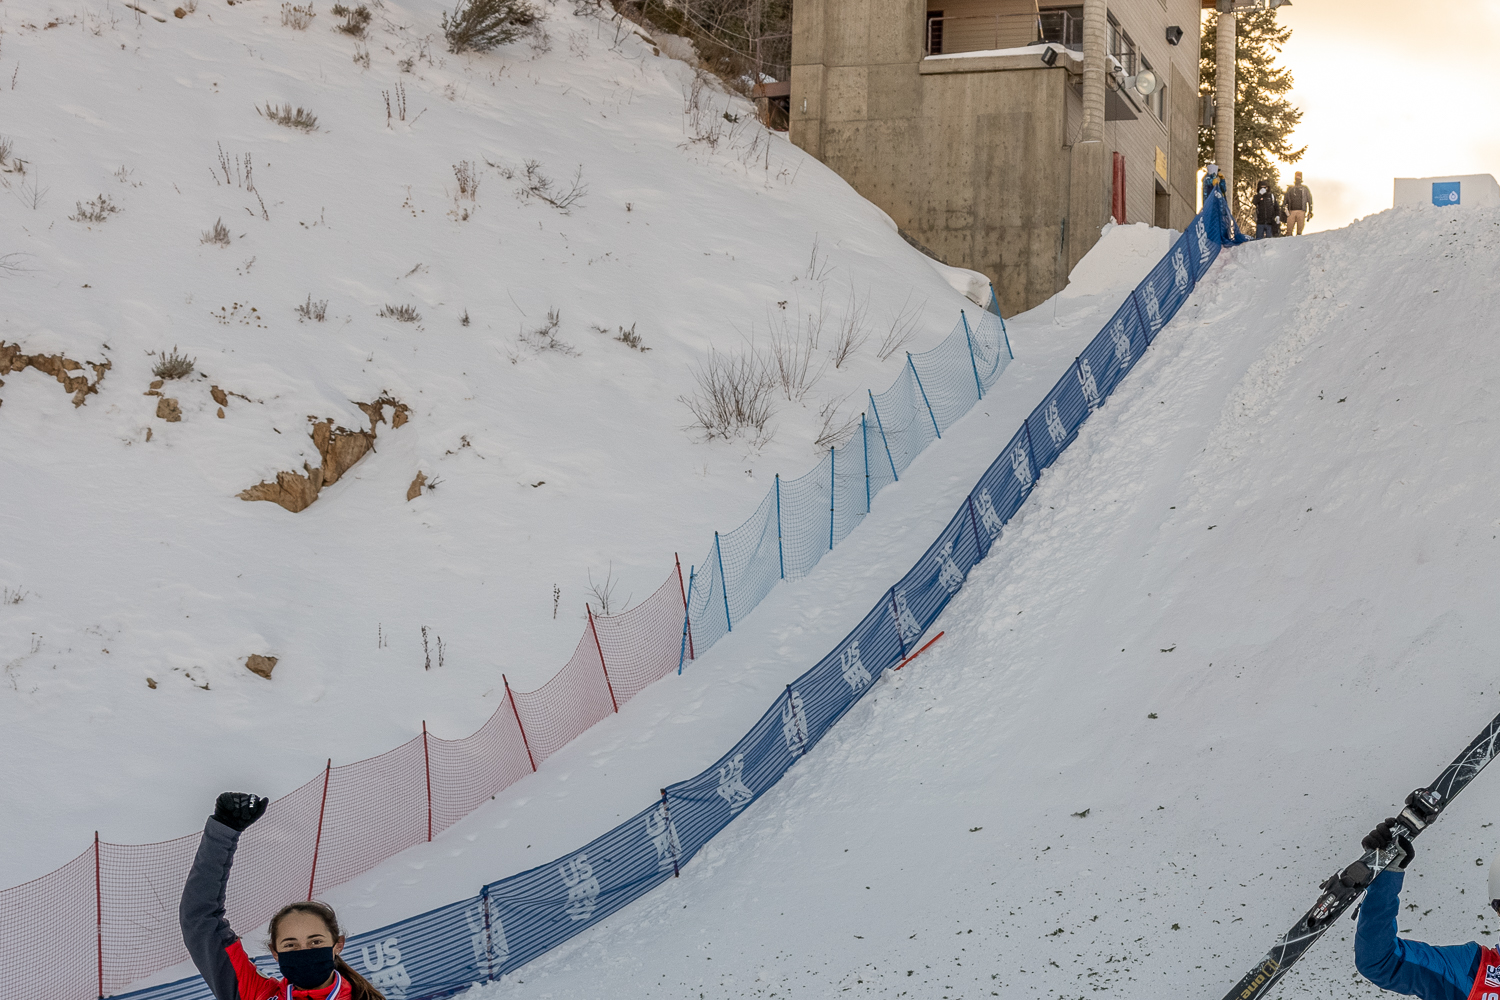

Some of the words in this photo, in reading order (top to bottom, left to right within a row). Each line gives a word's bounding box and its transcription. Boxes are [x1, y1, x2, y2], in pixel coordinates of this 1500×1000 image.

[974, 487, 992, 515] US
[840, 640, 861, 673] US
[719, 754, 744, 785] US
[558, 854, 593, 888] US
[361, 937, 401, 971] US
[1240, 974, 1265, 999] one
